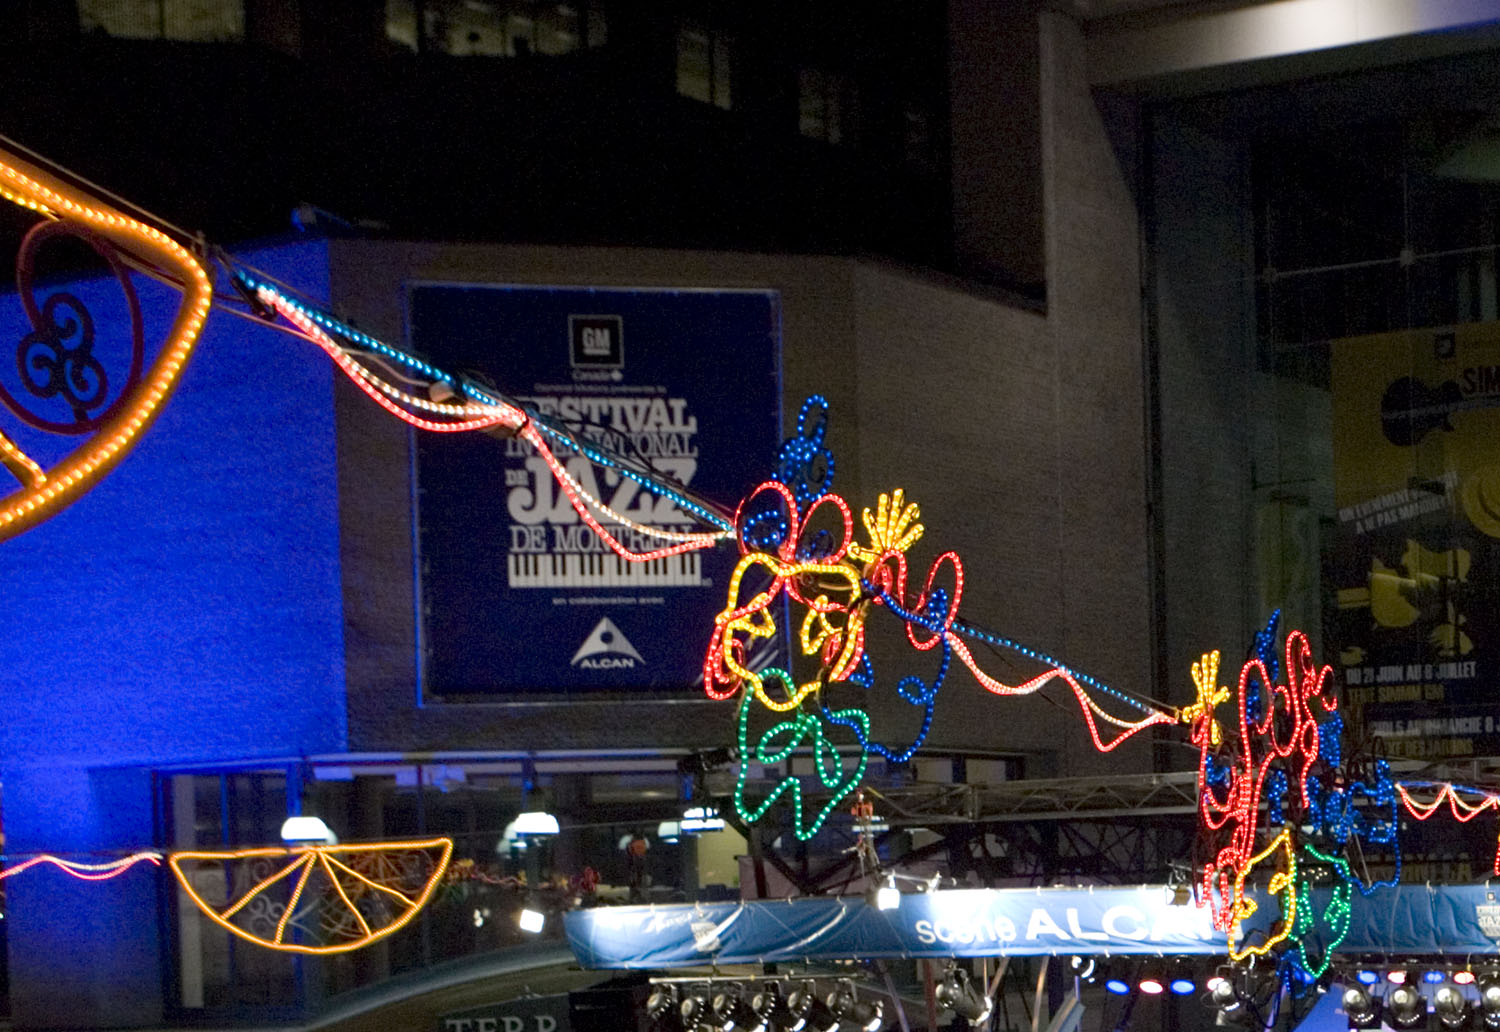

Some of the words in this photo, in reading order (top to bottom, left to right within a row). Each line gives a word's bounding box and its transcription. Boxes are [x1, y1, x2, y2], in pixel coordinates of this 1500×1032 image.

[581, 327, 611, 350] GM
[505, 470, 529, 486] DE
[507, 457, 697, 525] JAZZ
[510, 525, 546, 552] DE
[580, 658, 635, 669] ALCAN
[1437, 661, 1477, 680] JUILLET
